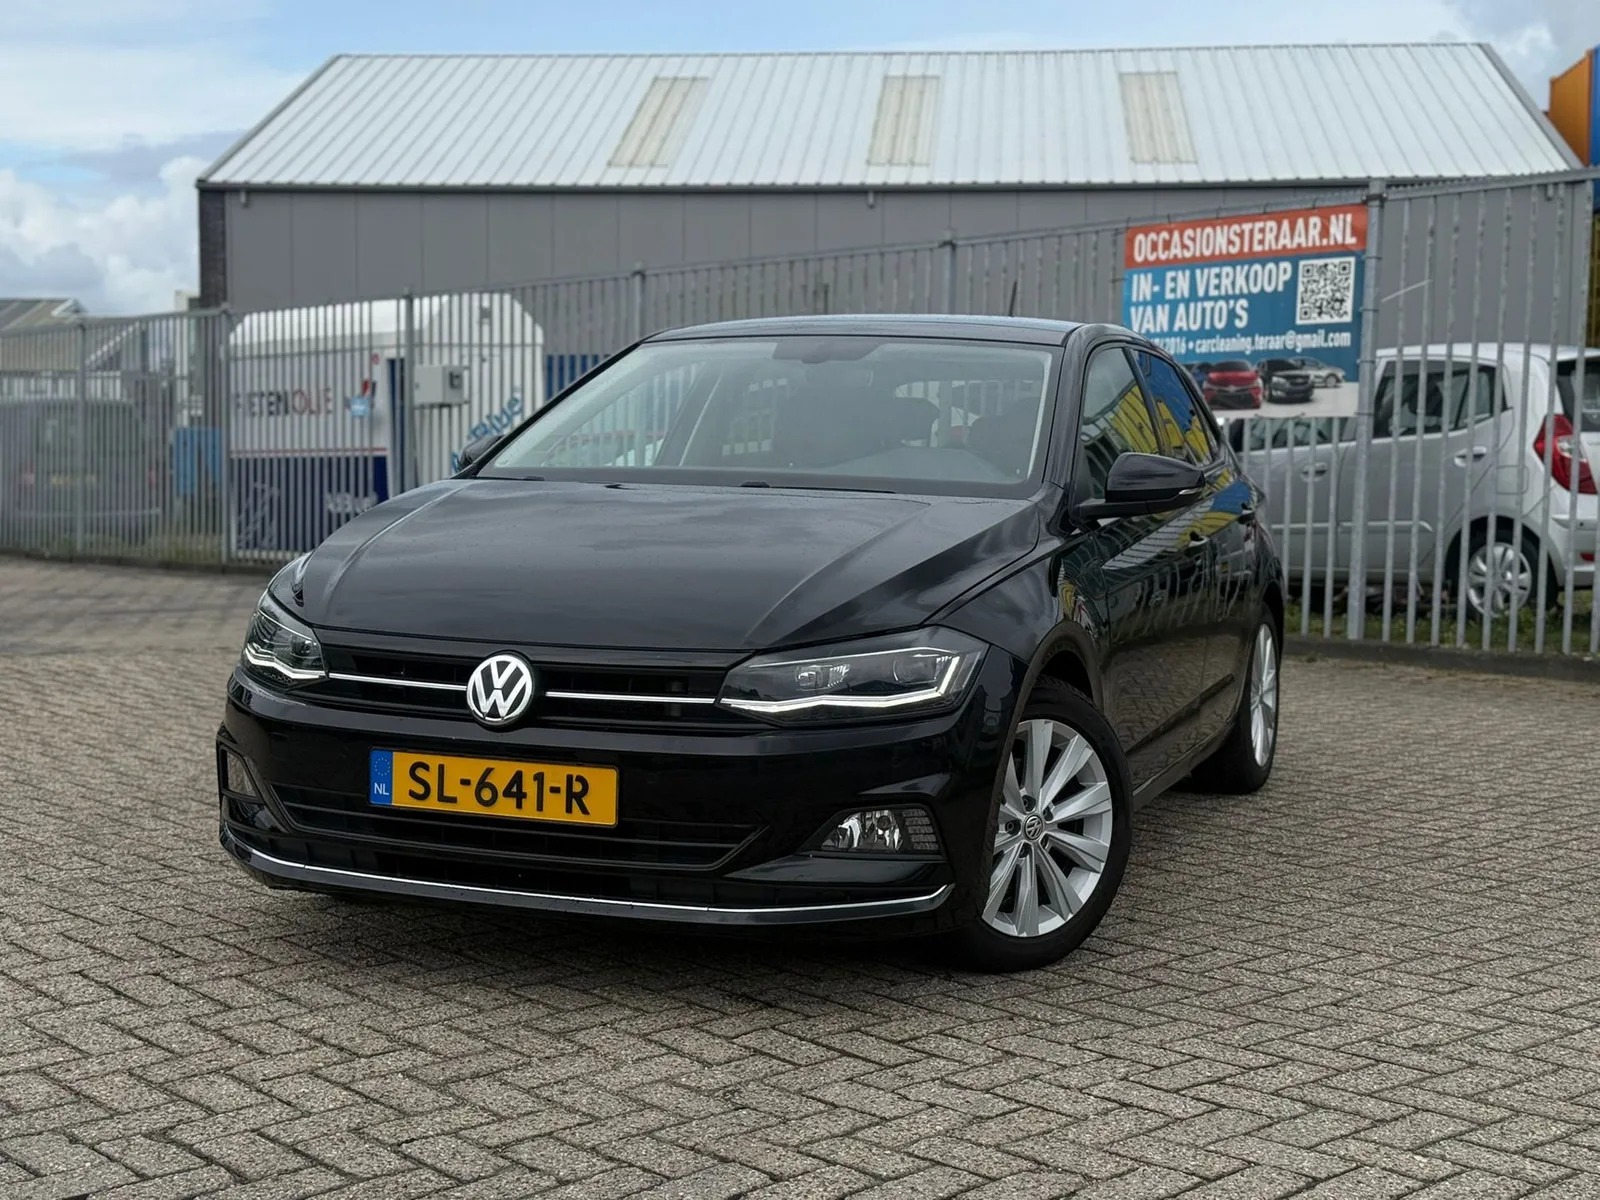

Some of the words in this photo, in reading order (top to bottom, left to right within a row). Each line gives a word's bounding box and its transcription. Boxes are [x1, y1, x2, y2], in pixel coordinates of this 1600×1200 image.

[1133, 213, 1357, 262] OCCASIONSTERAAR.NL
[1131, 272, 1161, 302] IN-
[1164, 269, 1190, 300] EN
[1195, 261, 1292, 298] VERKOOP
[1130, 305, 1170, 334] VAN
[1173, 298, 1249, 331] AUTO'S
[374, 782, 390, 796] NL
[408, 761, 590, 816] SL-641-R
